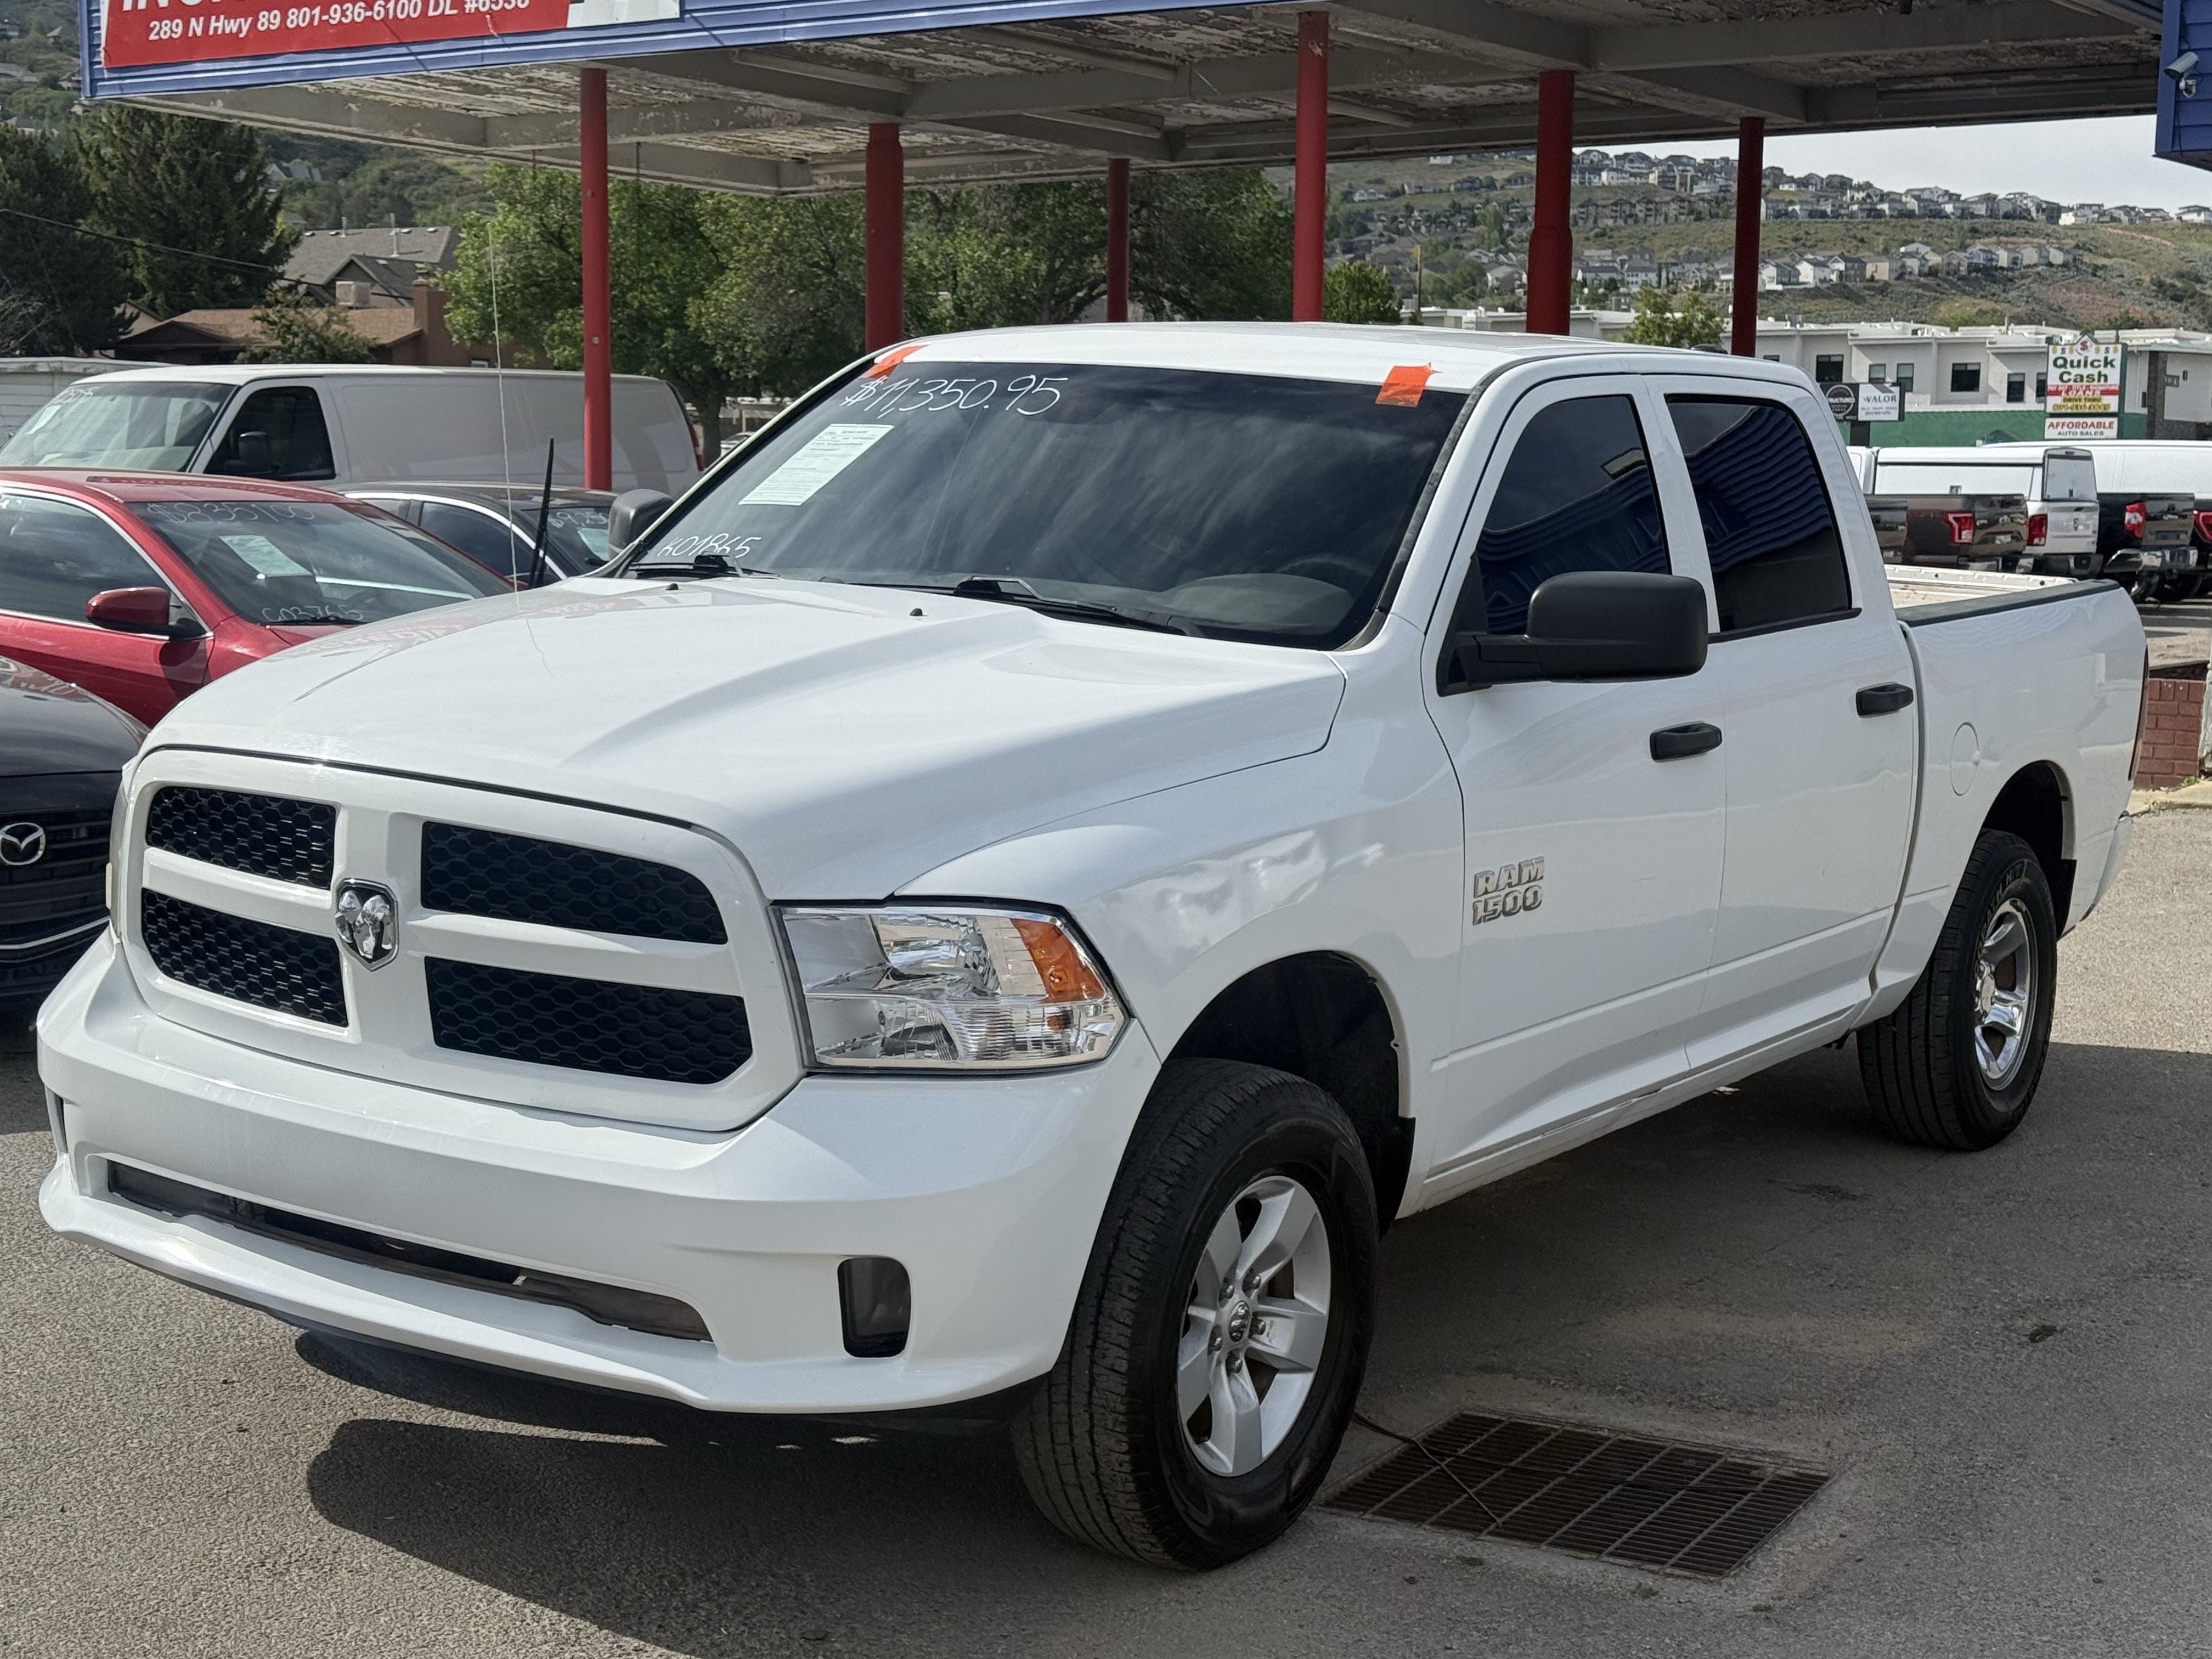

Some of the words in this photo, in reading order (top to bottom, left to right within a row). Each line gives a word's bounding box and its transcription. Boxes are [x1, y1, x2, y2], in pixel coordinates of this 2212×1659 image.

[148, 19, 183, 41] 289
[187, 16, 205, 37] N
[208, 14, 253, 38] Hwy
[257, 10, 281, 31] 89
[285, 0, 421, 29] 801-936-6100
[427, 0, 459, 17] DL
[2053, 356, 2116, 369] Quick
[2058, 371, 2108, 383] Cash
[839, 374, 1069, 419] $11,350.95
[1865, 394, 1897, 403] VALOR
[2047, 421, 2115, 430] AFFORDABLE
[1473, 856, 1545, 899] RAM
[1472, 885, 1543, 926] 1500
